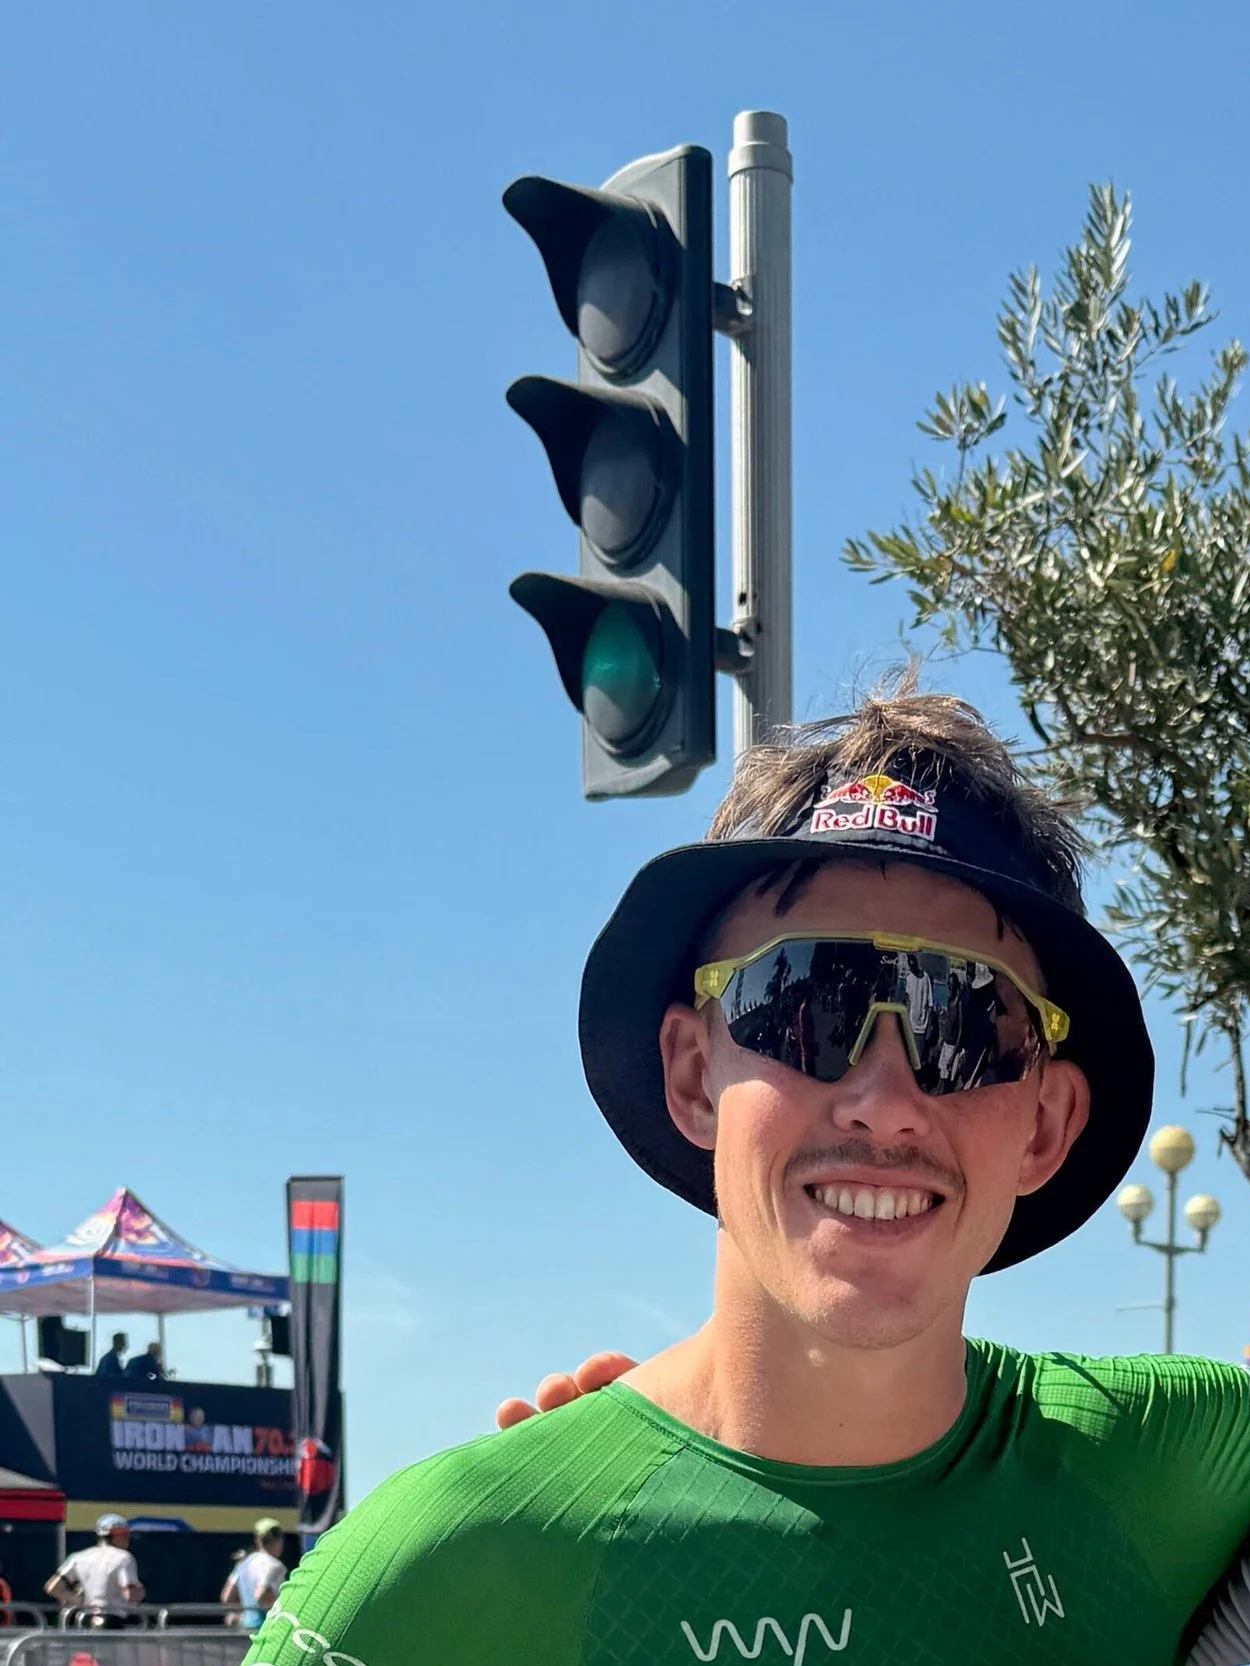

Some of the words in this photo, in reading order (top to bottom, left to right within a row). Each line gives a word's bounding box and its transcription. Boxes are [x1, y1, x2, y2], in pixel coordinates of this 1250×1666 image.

[811, 804, 874, 833] Red
[875, 805, 937, 842] Bull
[114, 1451, 177, 1471] WORLD
